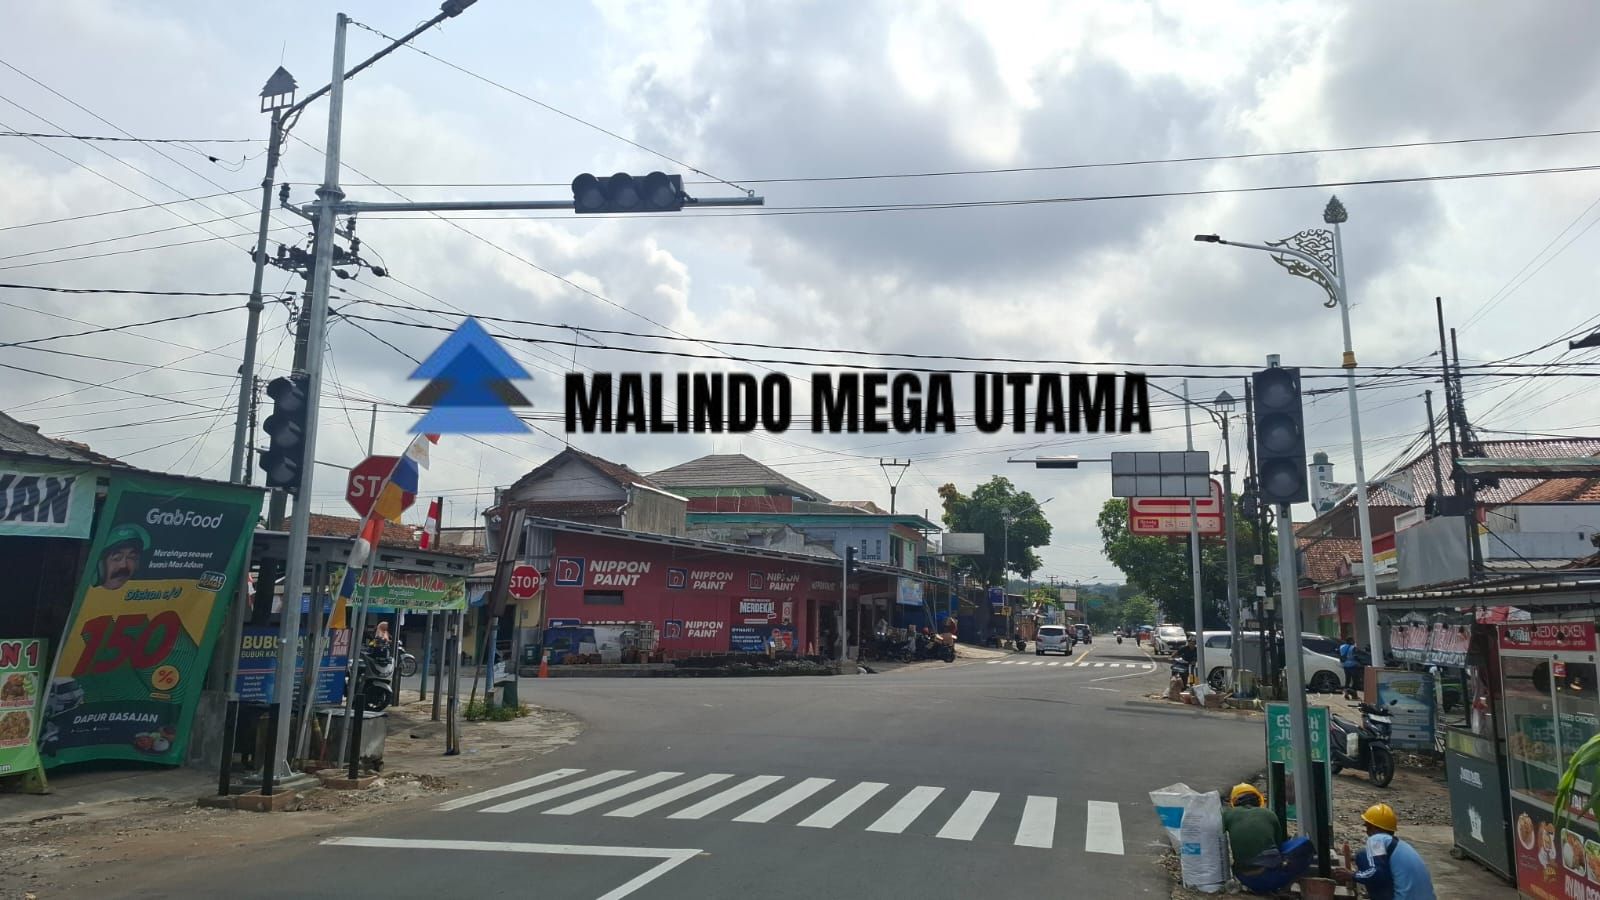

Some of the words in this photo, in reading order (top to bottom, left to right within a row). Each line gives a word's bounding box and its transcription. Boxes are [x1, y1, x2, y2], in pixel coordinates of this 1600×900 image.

[146, 508, 223, 529] GrabFood
[589, 560, 651, 573] NIPPON
[593, 574, 640, 586] PAINT
[690, 570, 734, 581] NIPPON
[510, 576, 539, 588] STOP
[693, 581, 726, 590] PAINT
[769, 582, 796, 591] PAINT
[685, 621, 724, 629] NIPPON
[687, 629, 718, 638] PAINT
[71, 611, 181, 677] 150
[73, 713, 107, 724] DAPUR
[108, 713, 158, 723] BASAJAN
